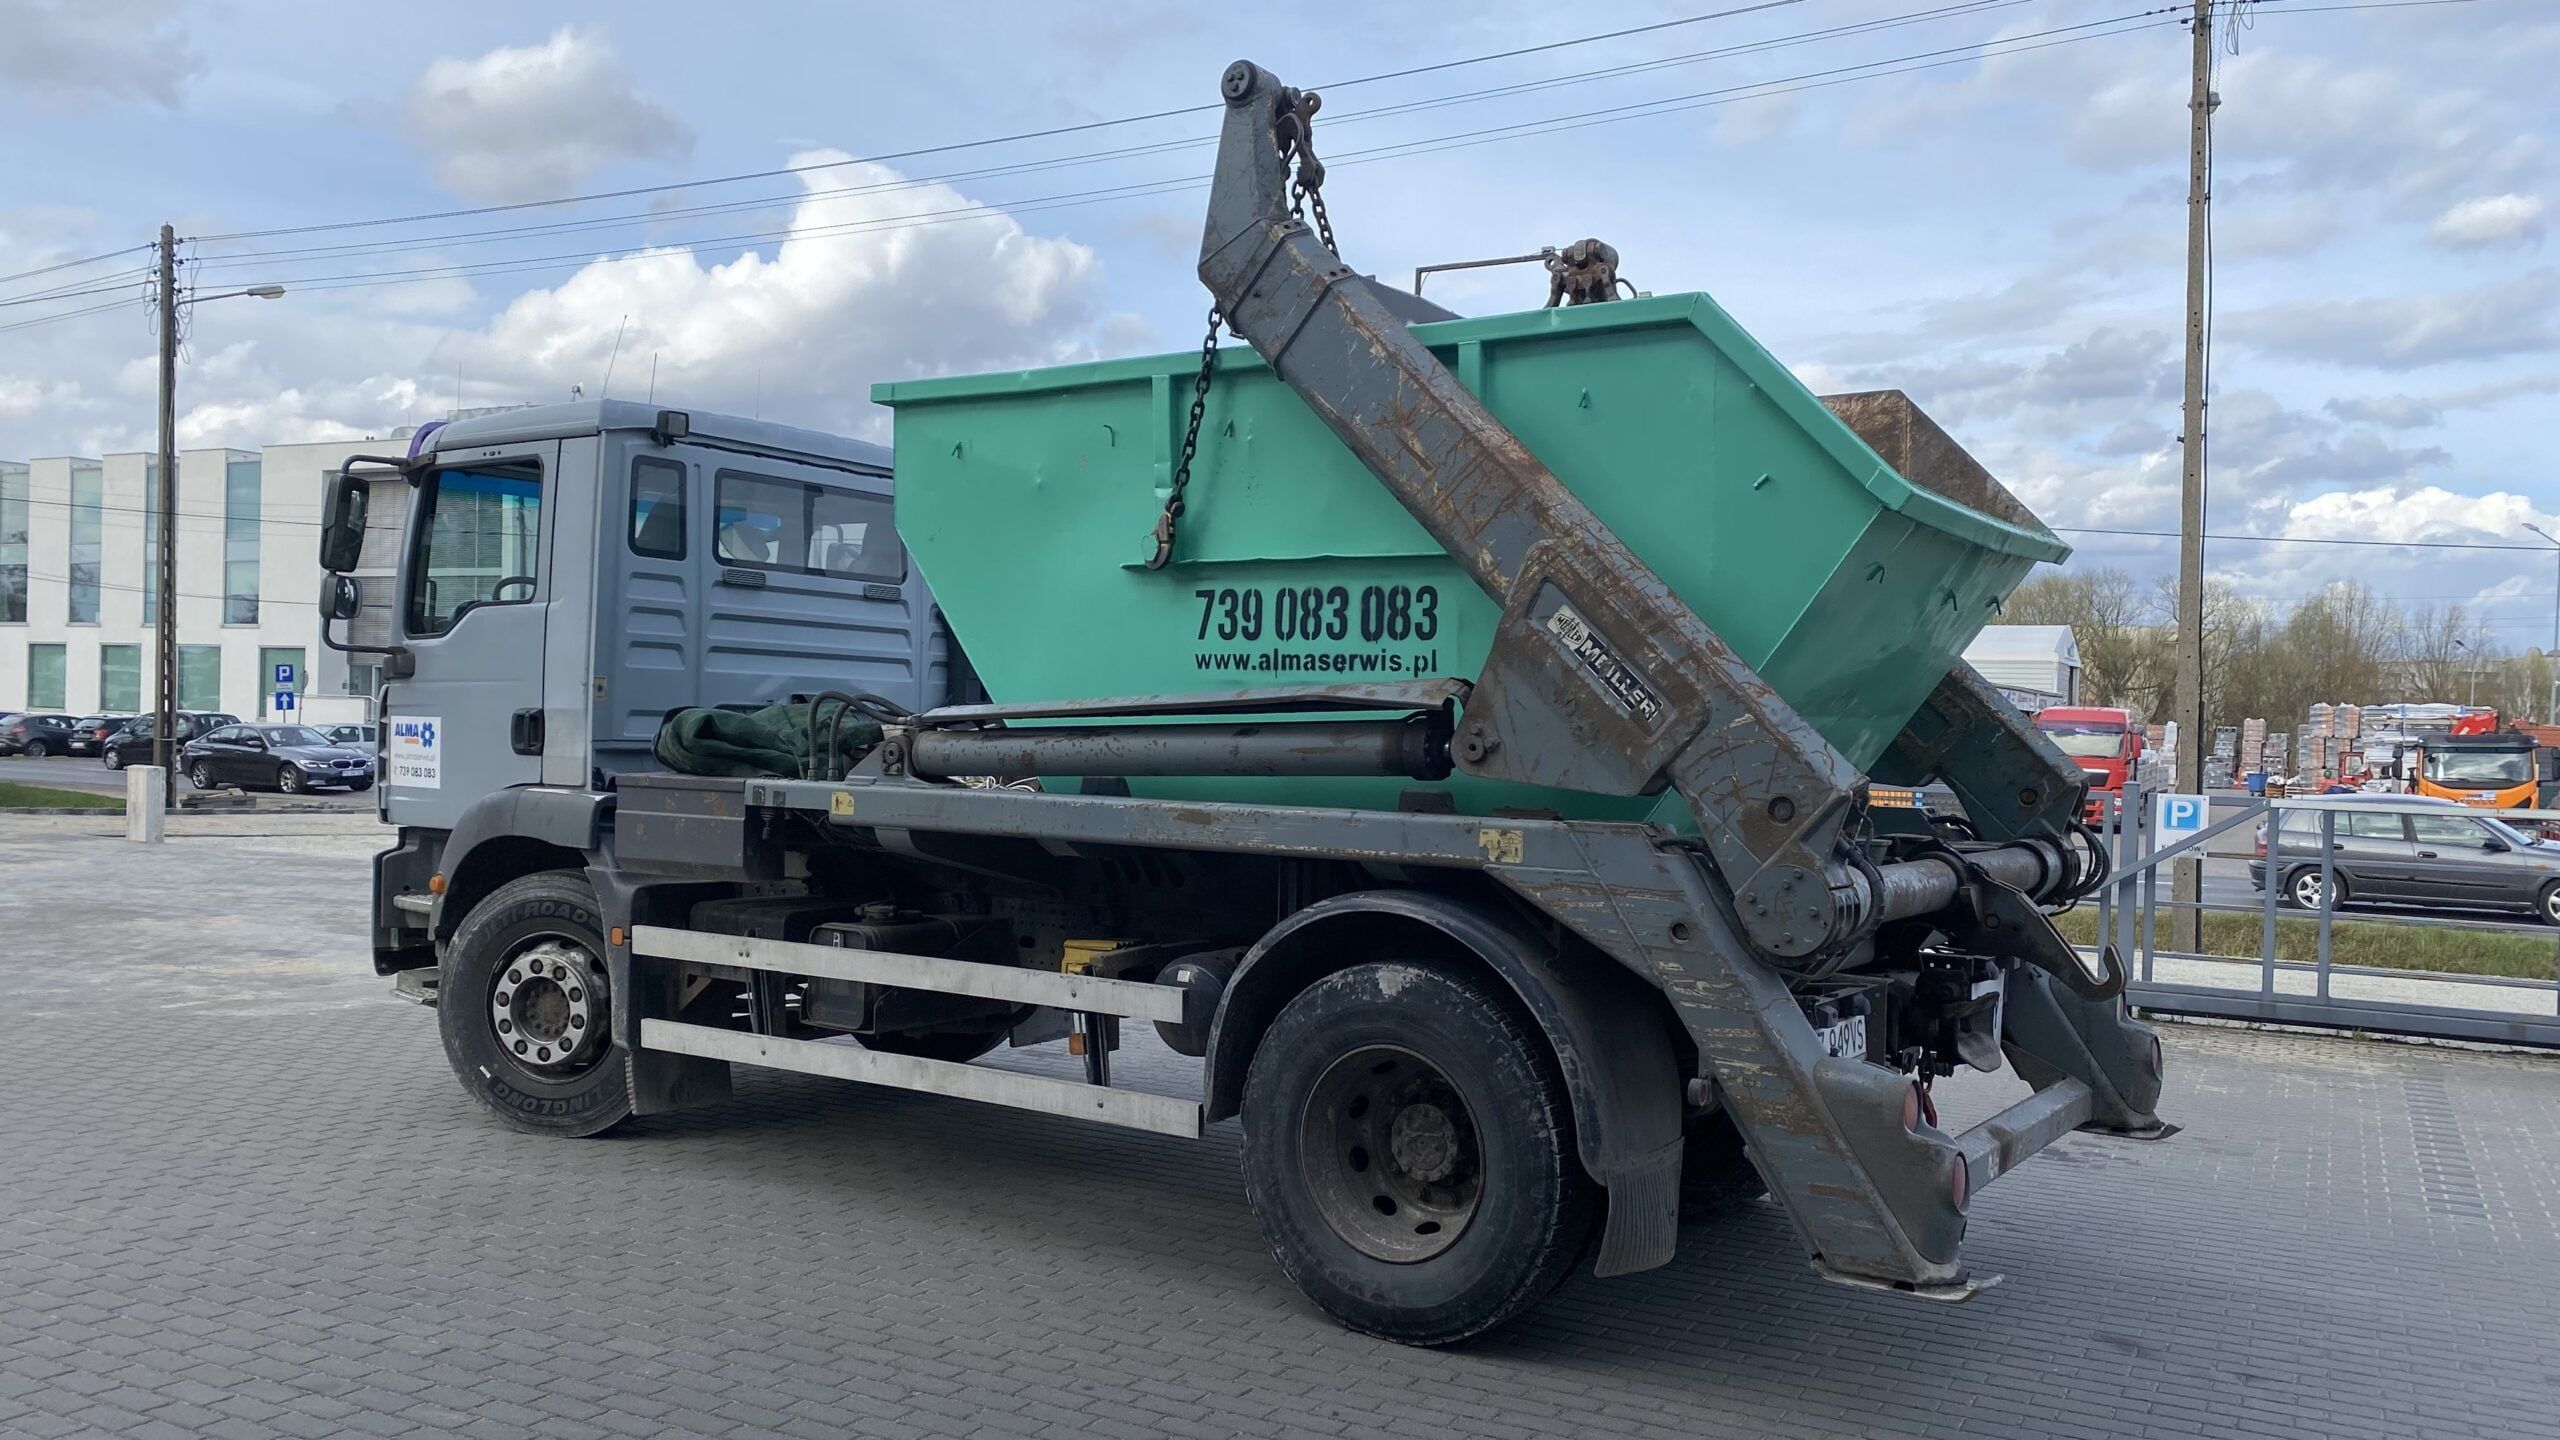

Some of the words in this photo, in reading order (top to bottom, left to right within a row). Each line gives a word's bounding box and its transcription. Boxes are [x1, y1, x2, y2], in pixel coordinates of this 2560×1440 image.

[1195, 588, 1263, 641] 739
[1275, 587, 1349, 641] 083
[1360, 585, 1438, 642] 083
[279, 666, 290, 681] P
[1195, 648, 1437, 678] www.almaserwis.pl
[1580, 639, 1656, 718] MEILLER
[395, 723, 419, 737] ALMA
[400, 765, 410, 777] 739
[411, 766, 422, 777] 083
[424, 767, 435, 779] 083
[2171, 801, 2194, 827] P
[494, 1083, 600, 1114] LINGLONG
